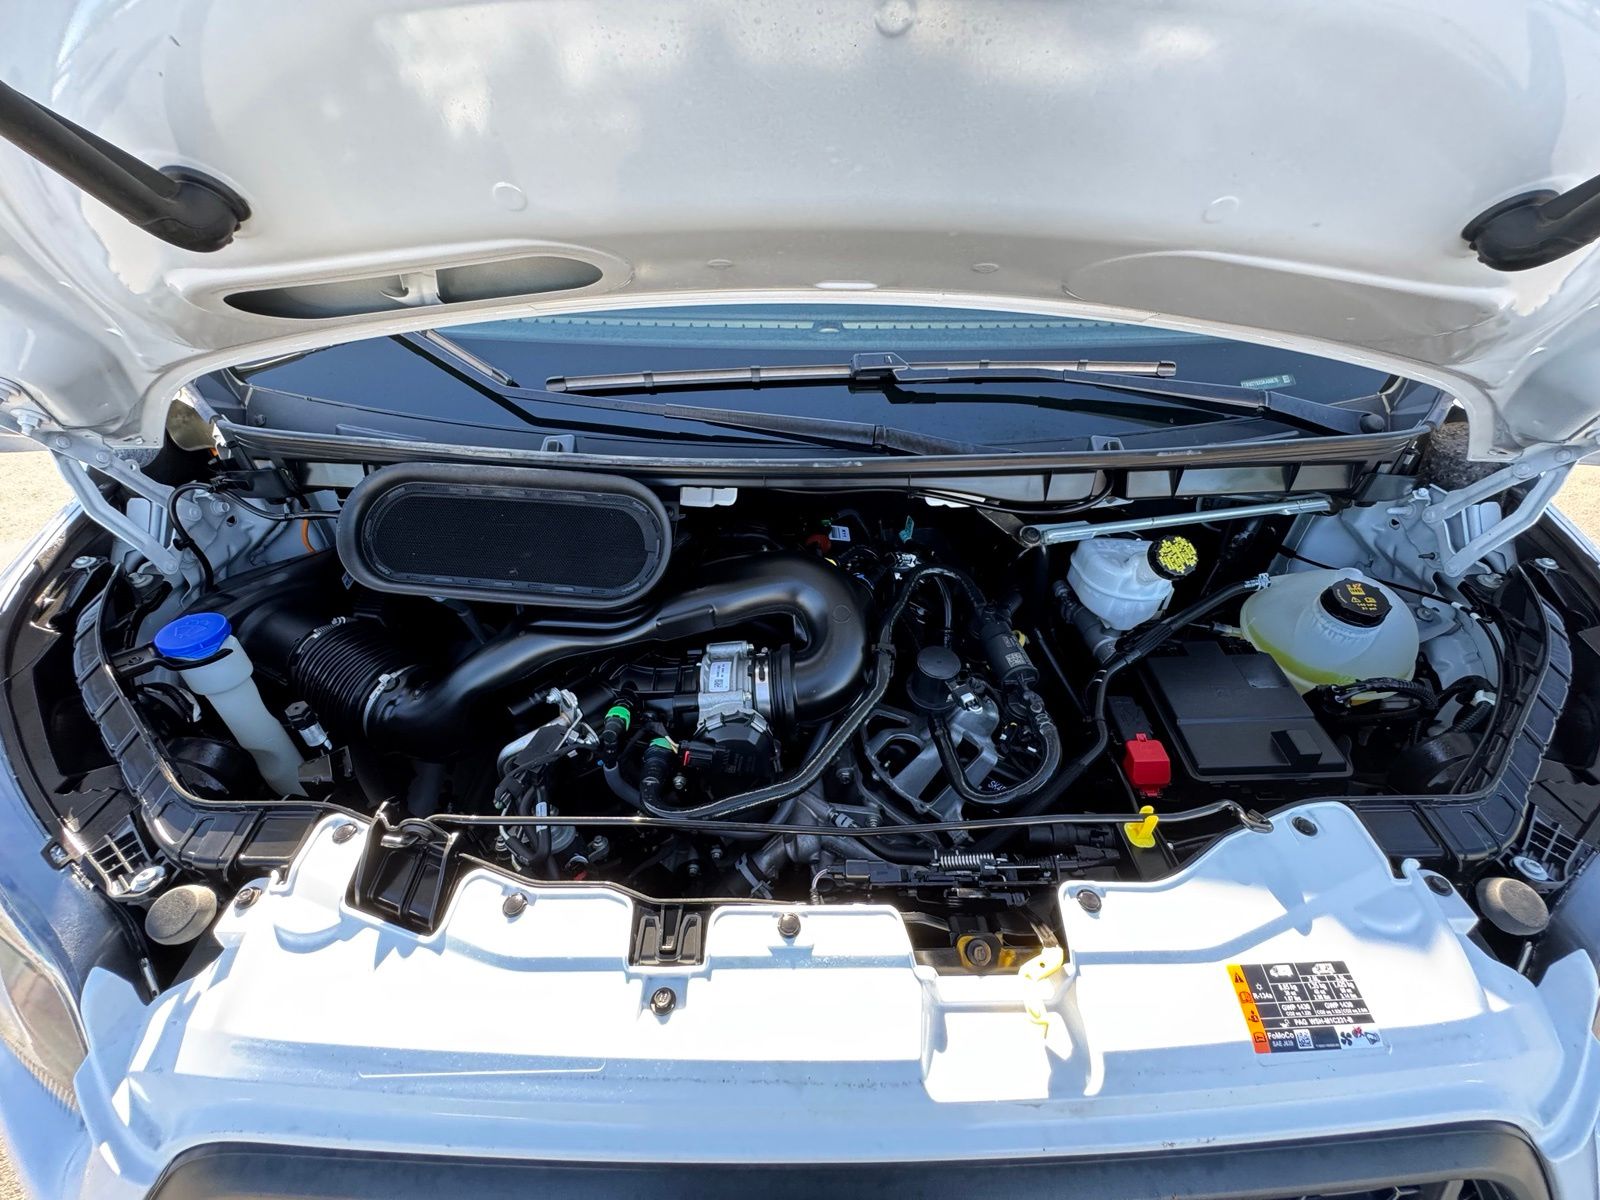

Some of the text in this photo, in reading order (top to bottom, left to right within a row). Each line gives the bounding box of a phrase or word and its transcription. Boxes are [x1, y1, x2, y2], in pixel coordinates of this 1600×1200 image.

[1252, 992, 1273, 1000] R-134a
[1293, 1017, 1308, 1026] PAG
[1267, 1031, 1295, 1040] FoMoCo
